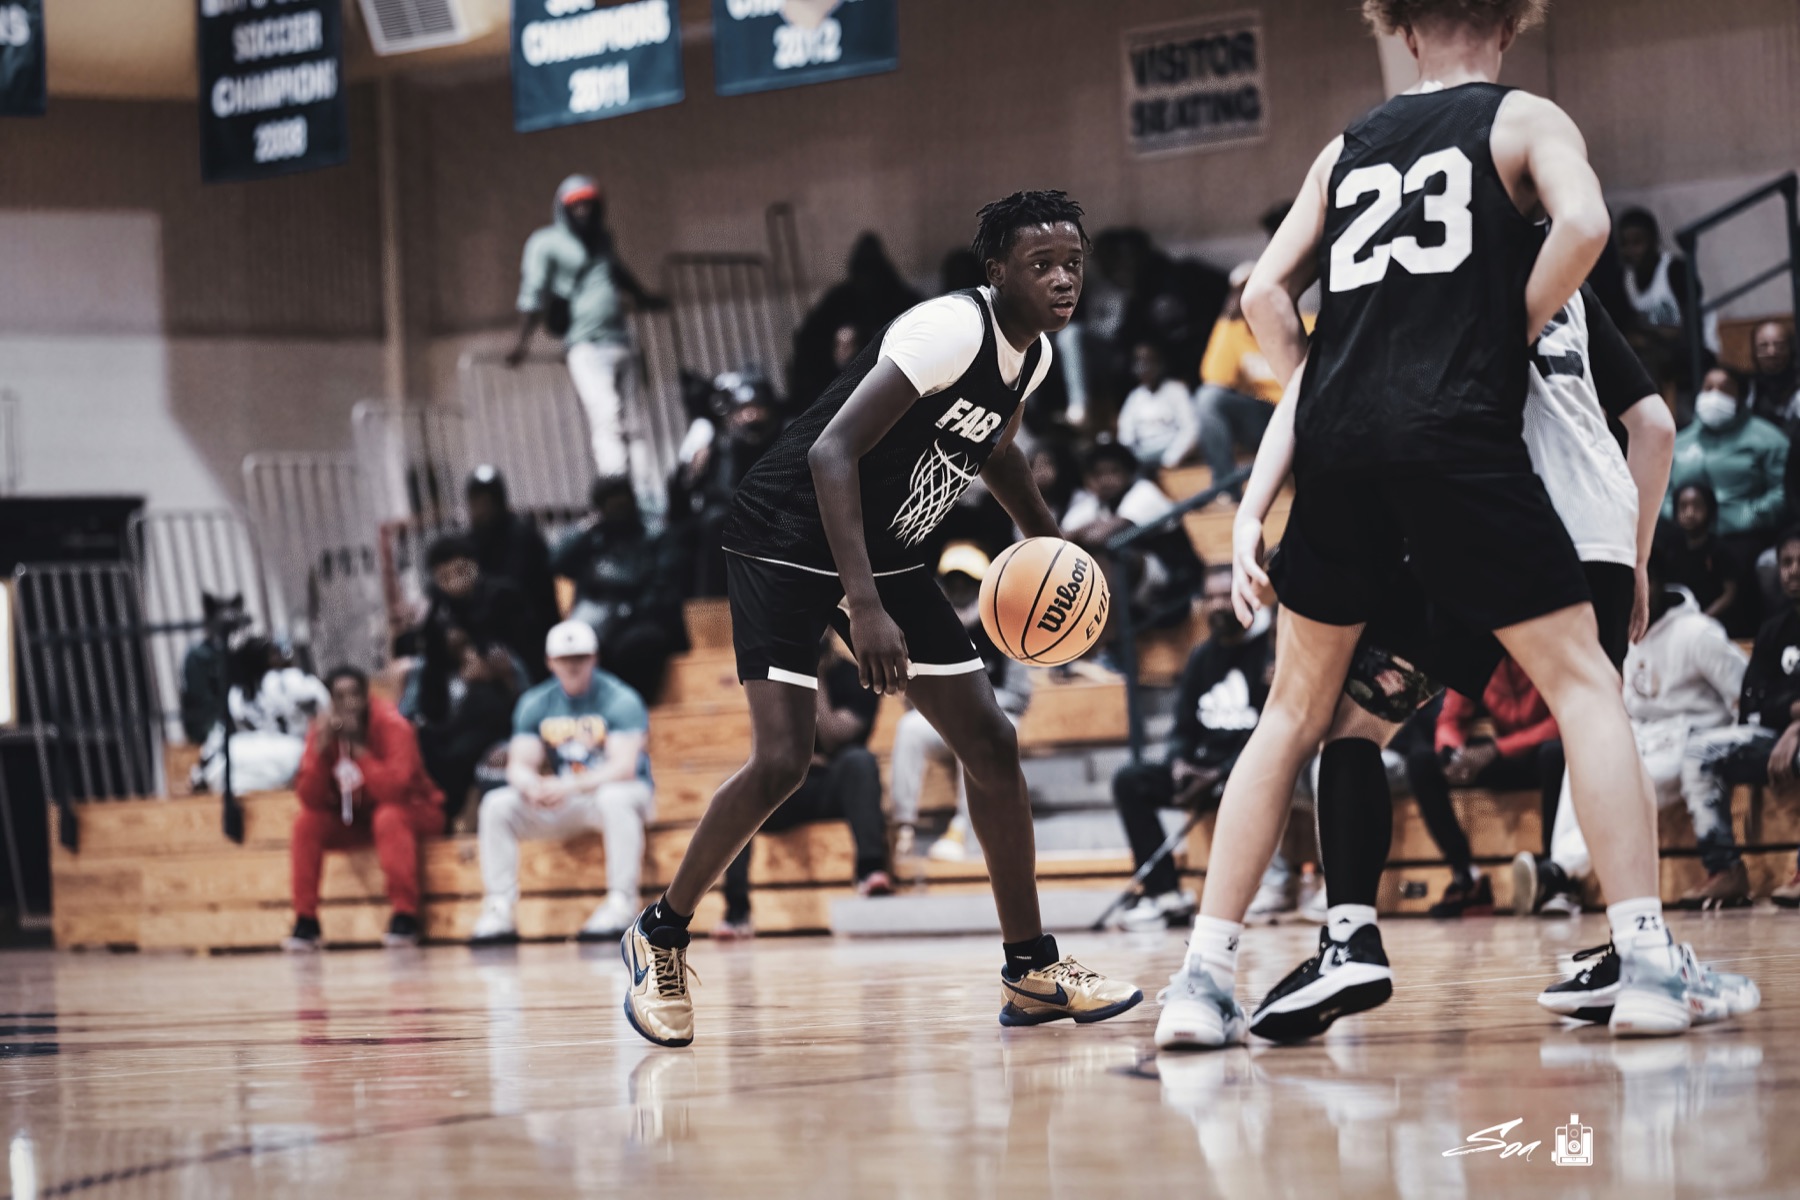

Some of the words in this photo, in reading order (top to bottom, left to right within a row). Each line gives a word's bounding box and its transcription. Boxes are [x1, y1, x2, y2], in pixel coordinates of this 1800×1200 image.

[521, 0, 671, 67] CHAMPIONS
[1129, 31, 1257, 88] VISITOR
[568, 59, 630, 114] 2011
[1131, 84, 1262, 138] SEATING
[1329, 146, 1473, 293] 23
[934, 397, 1002, 443] FAB
[1036, 557, 1088, 633] Wilson
